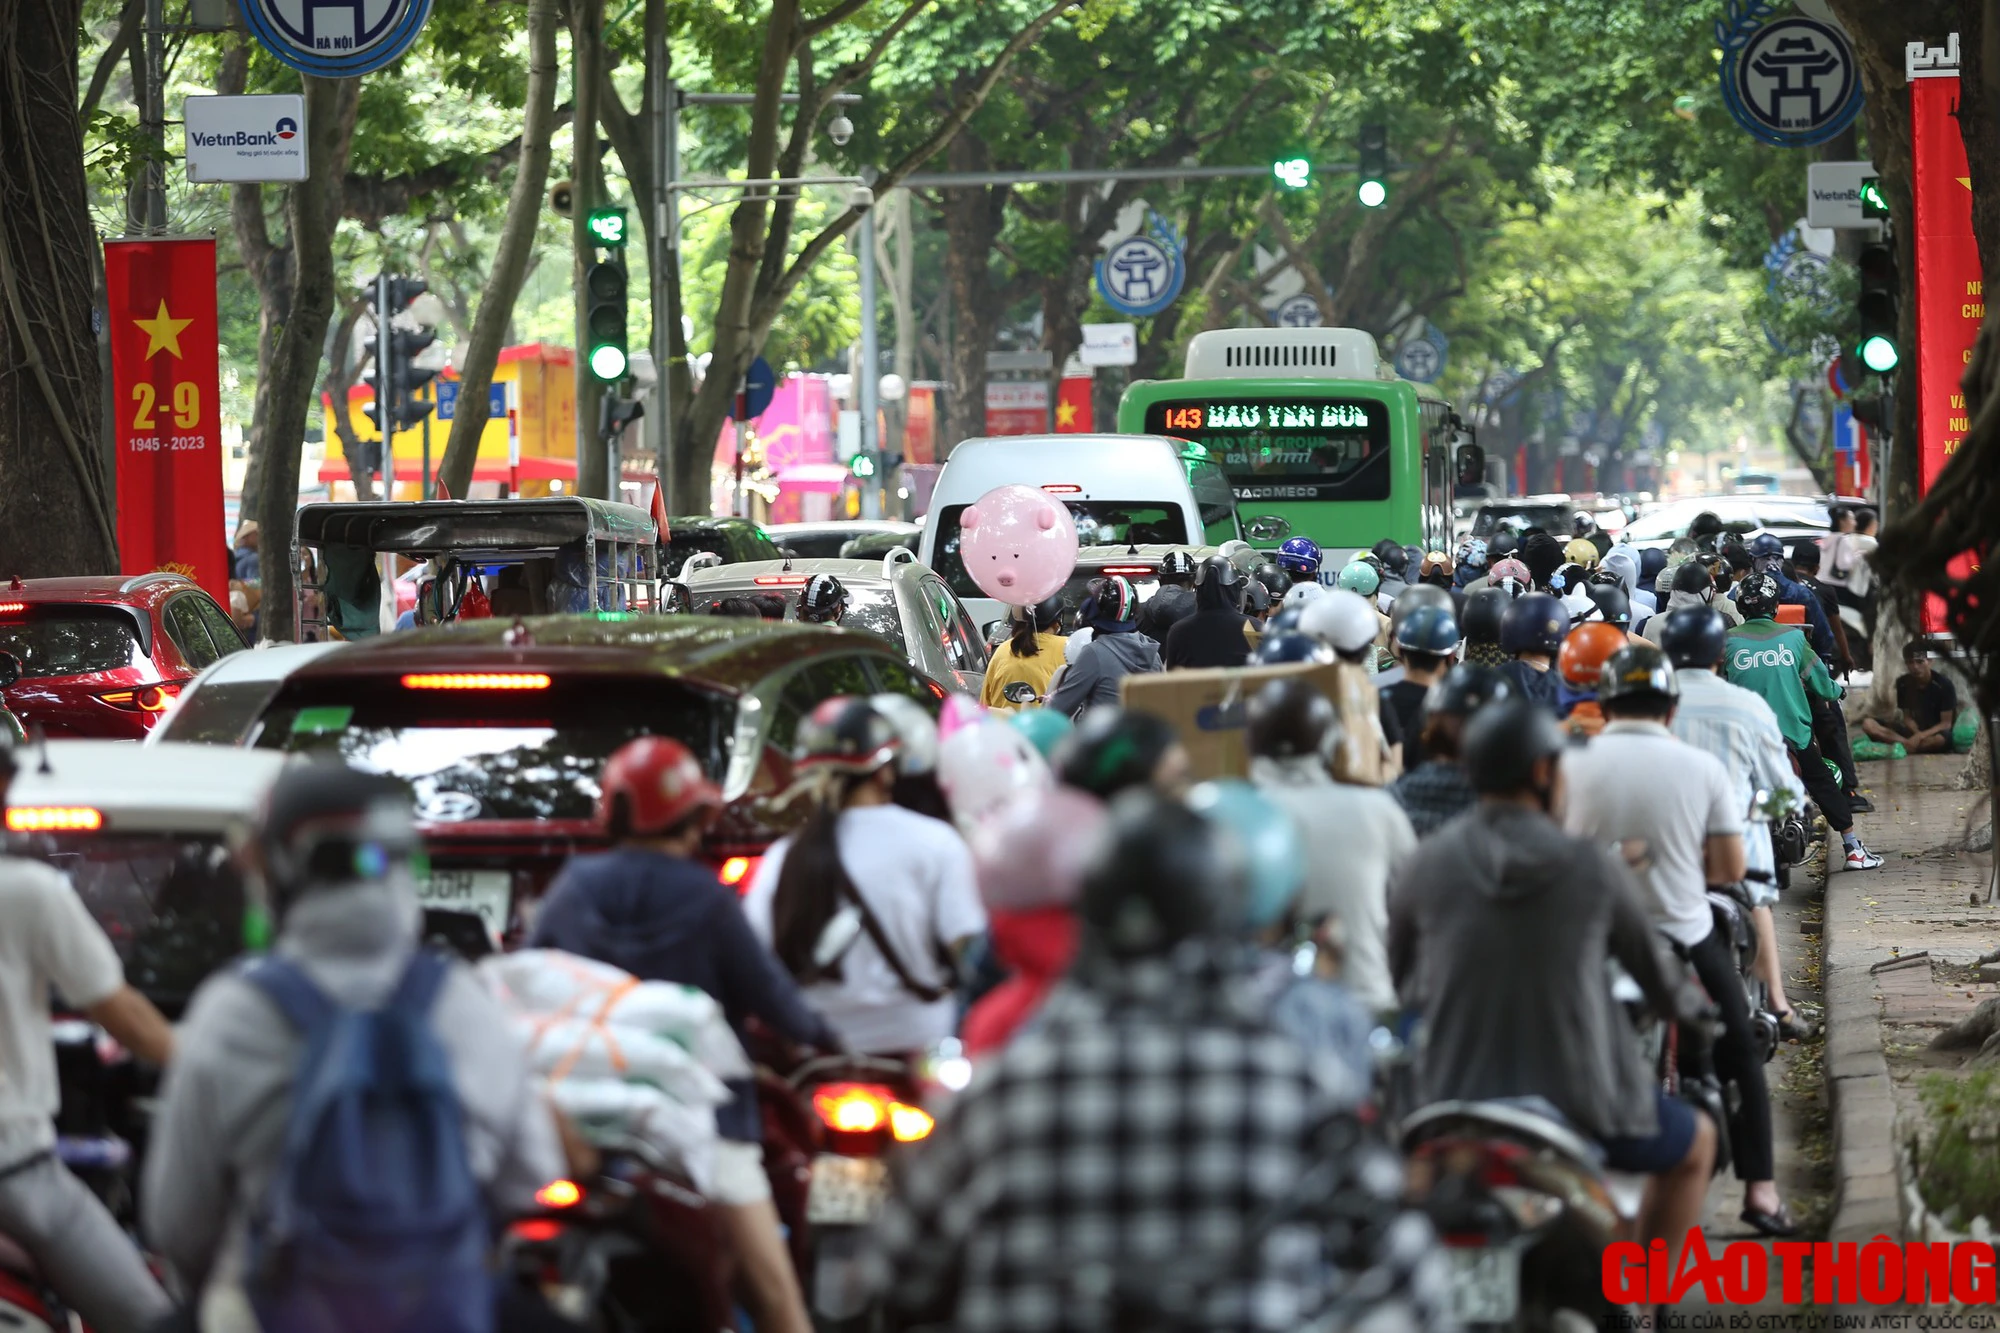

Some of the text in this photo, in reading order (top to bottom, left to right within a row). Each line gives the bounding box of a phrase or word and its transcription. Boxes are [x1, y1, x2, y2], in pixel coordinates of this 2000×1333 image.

[316, 35, 352, 51] HÀ NỘI
[191, 131, 278, 147] VietinBank
[132, 381, 200, 430] 2-9
[1166, 408, 1202, 429] 143
[129, 437, 160, 452] 1945
[171, 436, 205, 451] 2023
[1274, 436, 1328, 449] GROUP
[1734, 644, 1795, 670] Grab
